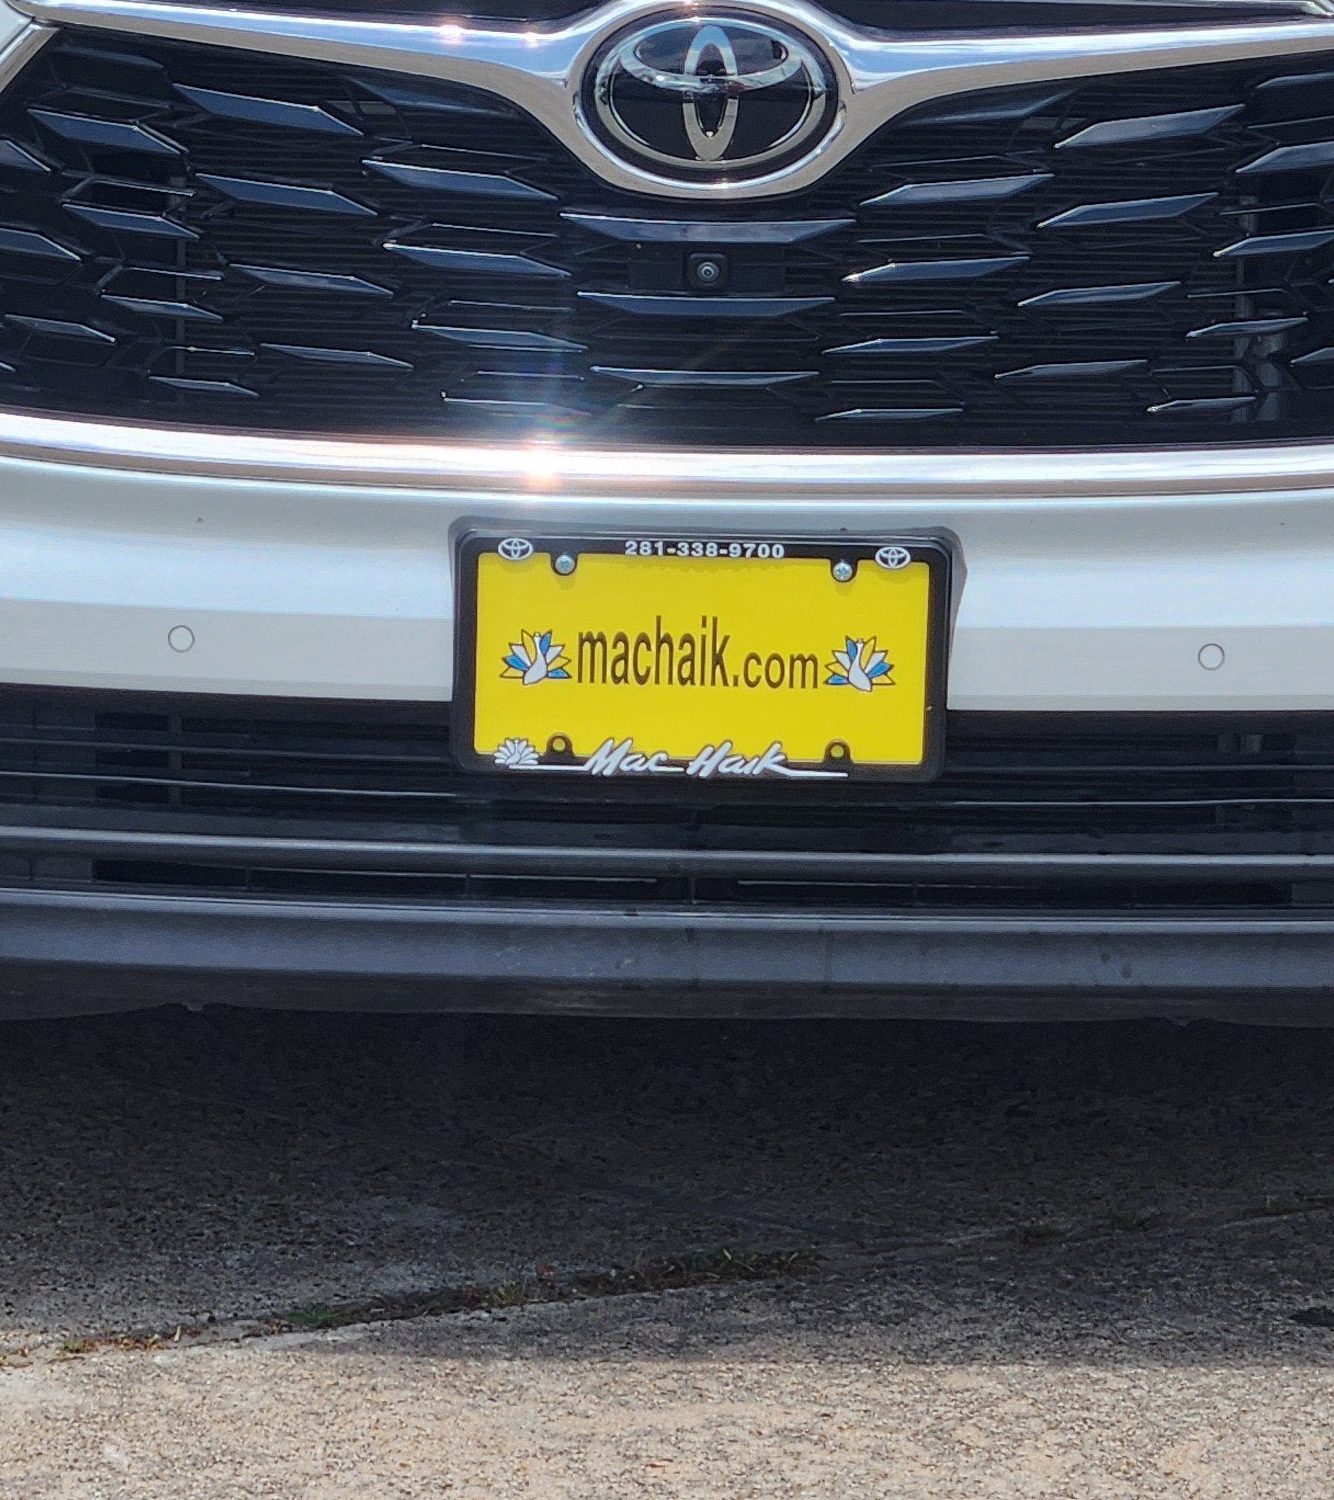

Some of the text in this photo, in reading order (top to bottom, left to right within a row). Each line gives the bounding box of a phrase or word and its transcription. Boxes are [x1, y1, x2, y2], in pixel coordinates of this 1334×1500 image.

[624, 540, 785, 559] 281-338-9700
[577, 615, 818, 689] machaik.com
[581, 737, 799, 778] Mac Haik
